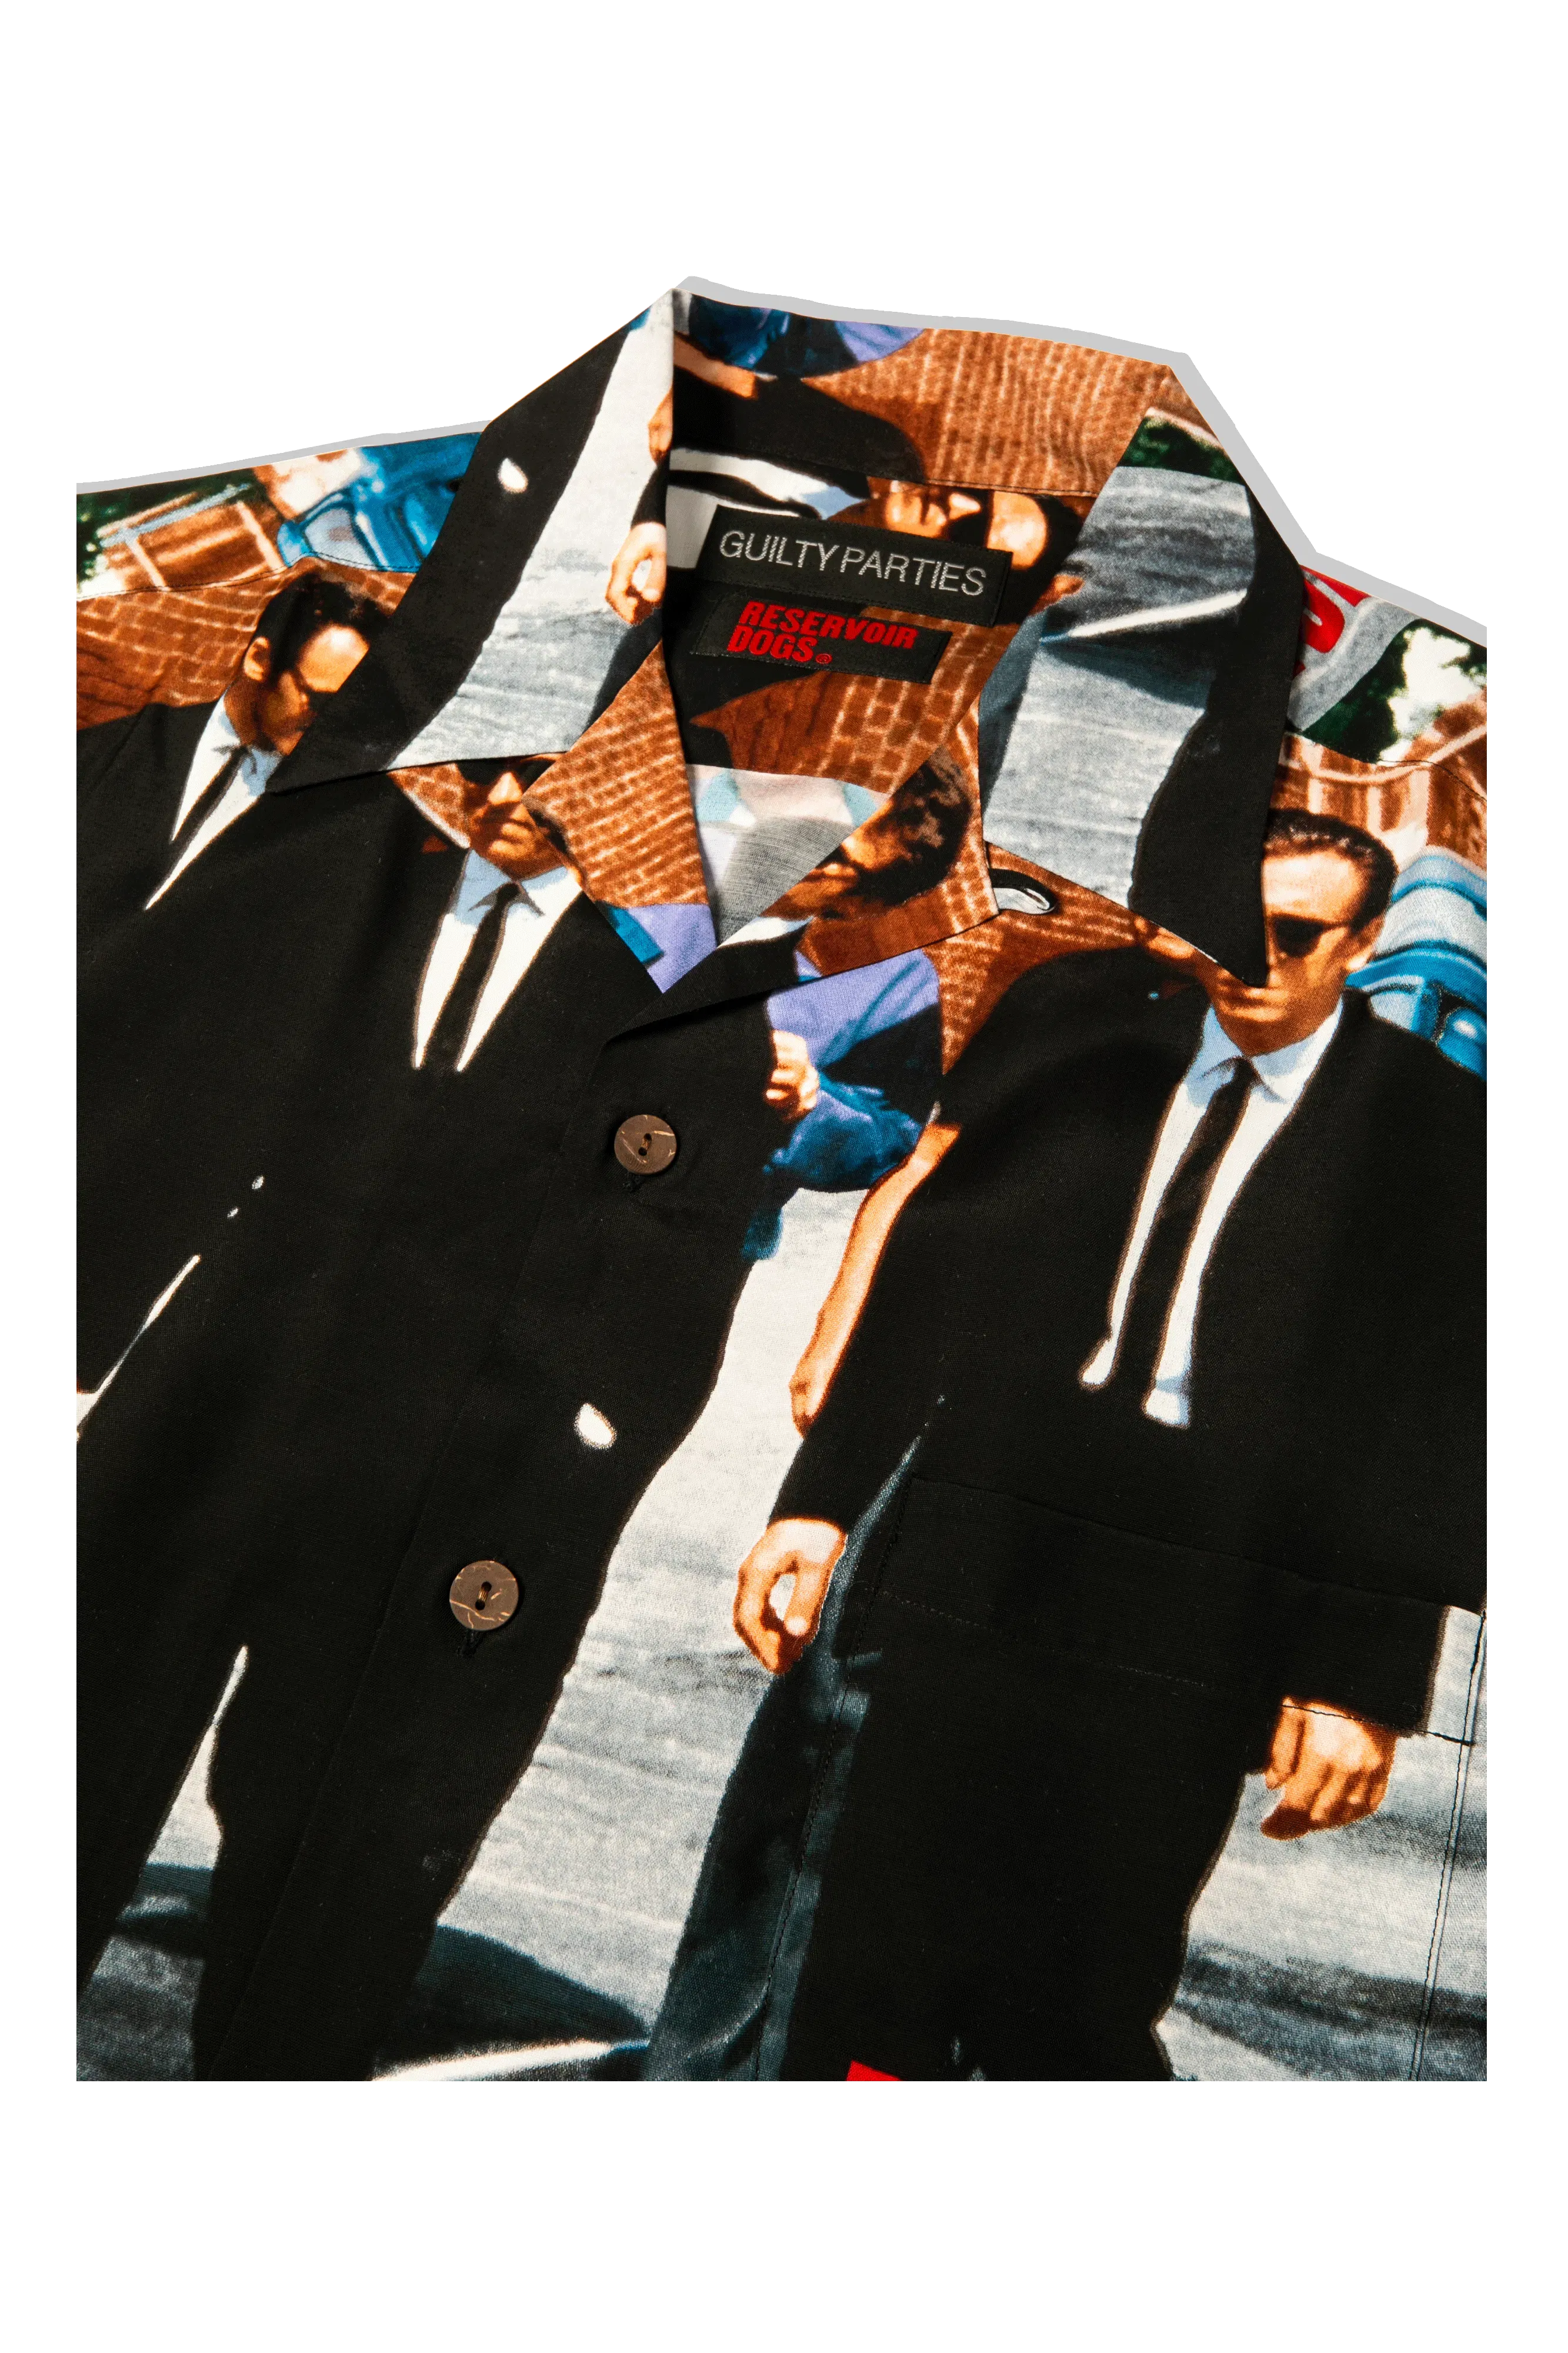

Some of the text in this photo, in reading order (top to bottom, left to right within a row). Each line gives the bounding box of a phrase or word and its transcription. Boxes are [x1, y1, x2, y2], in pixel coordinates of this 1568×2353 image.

[719, 530, 987, 596] GUILTY PARTIES
[738, 601, 919, 649] RESERVOIR
